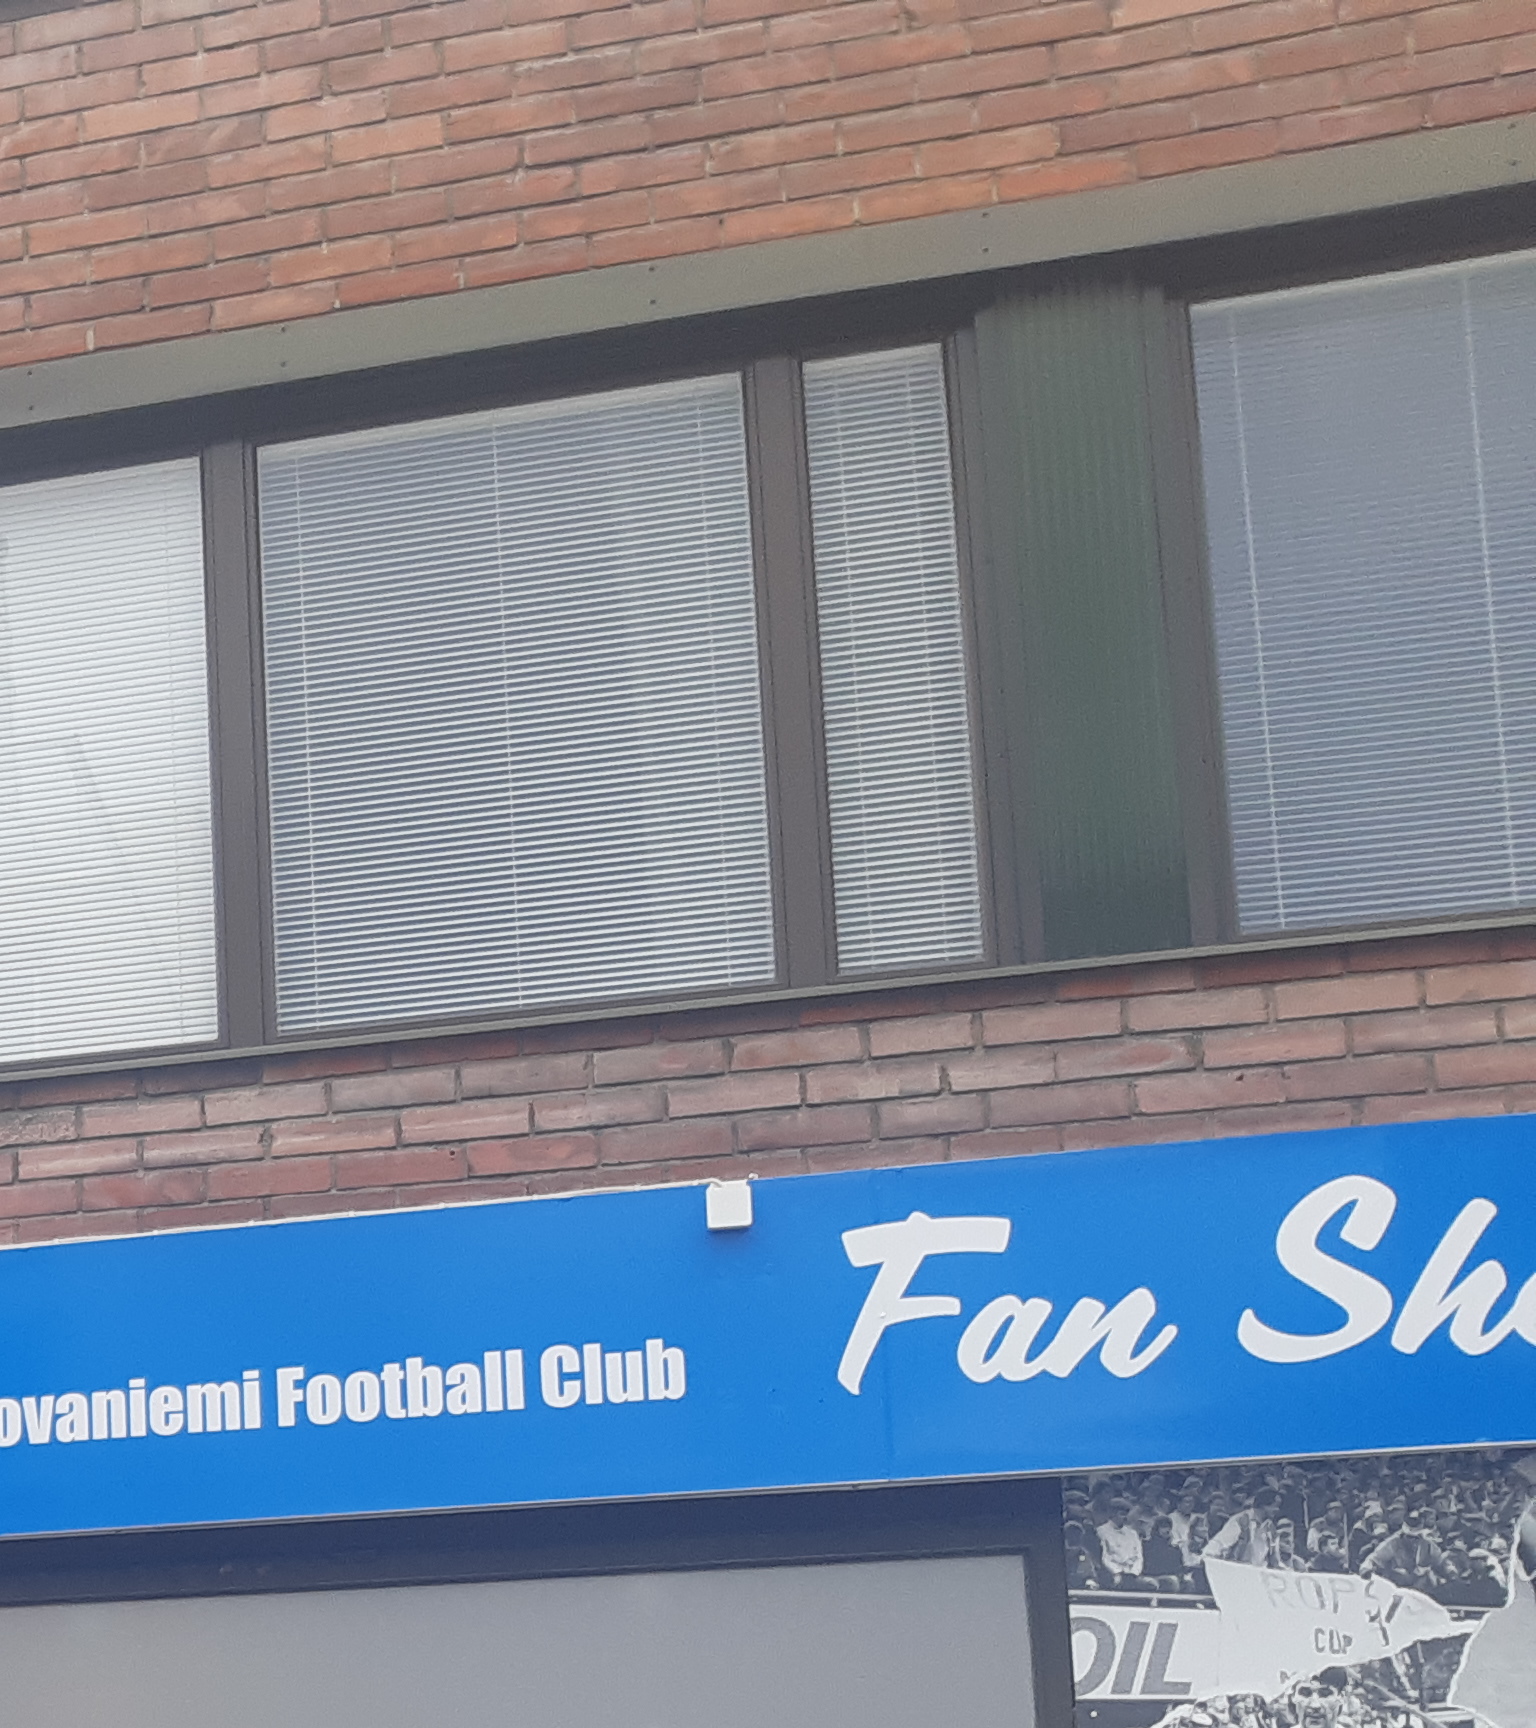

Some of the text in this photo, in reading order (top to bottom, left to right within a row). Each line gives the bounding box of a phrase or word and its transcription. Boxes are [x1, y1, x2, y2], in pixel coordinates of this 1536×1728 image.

[835, 1211, 1178, 1396] Fan
[277, 1348, 523, 1431] Football
[540, 1339, 687, 1408] Club
[1314, 1627, 1353, 1655] CUP
